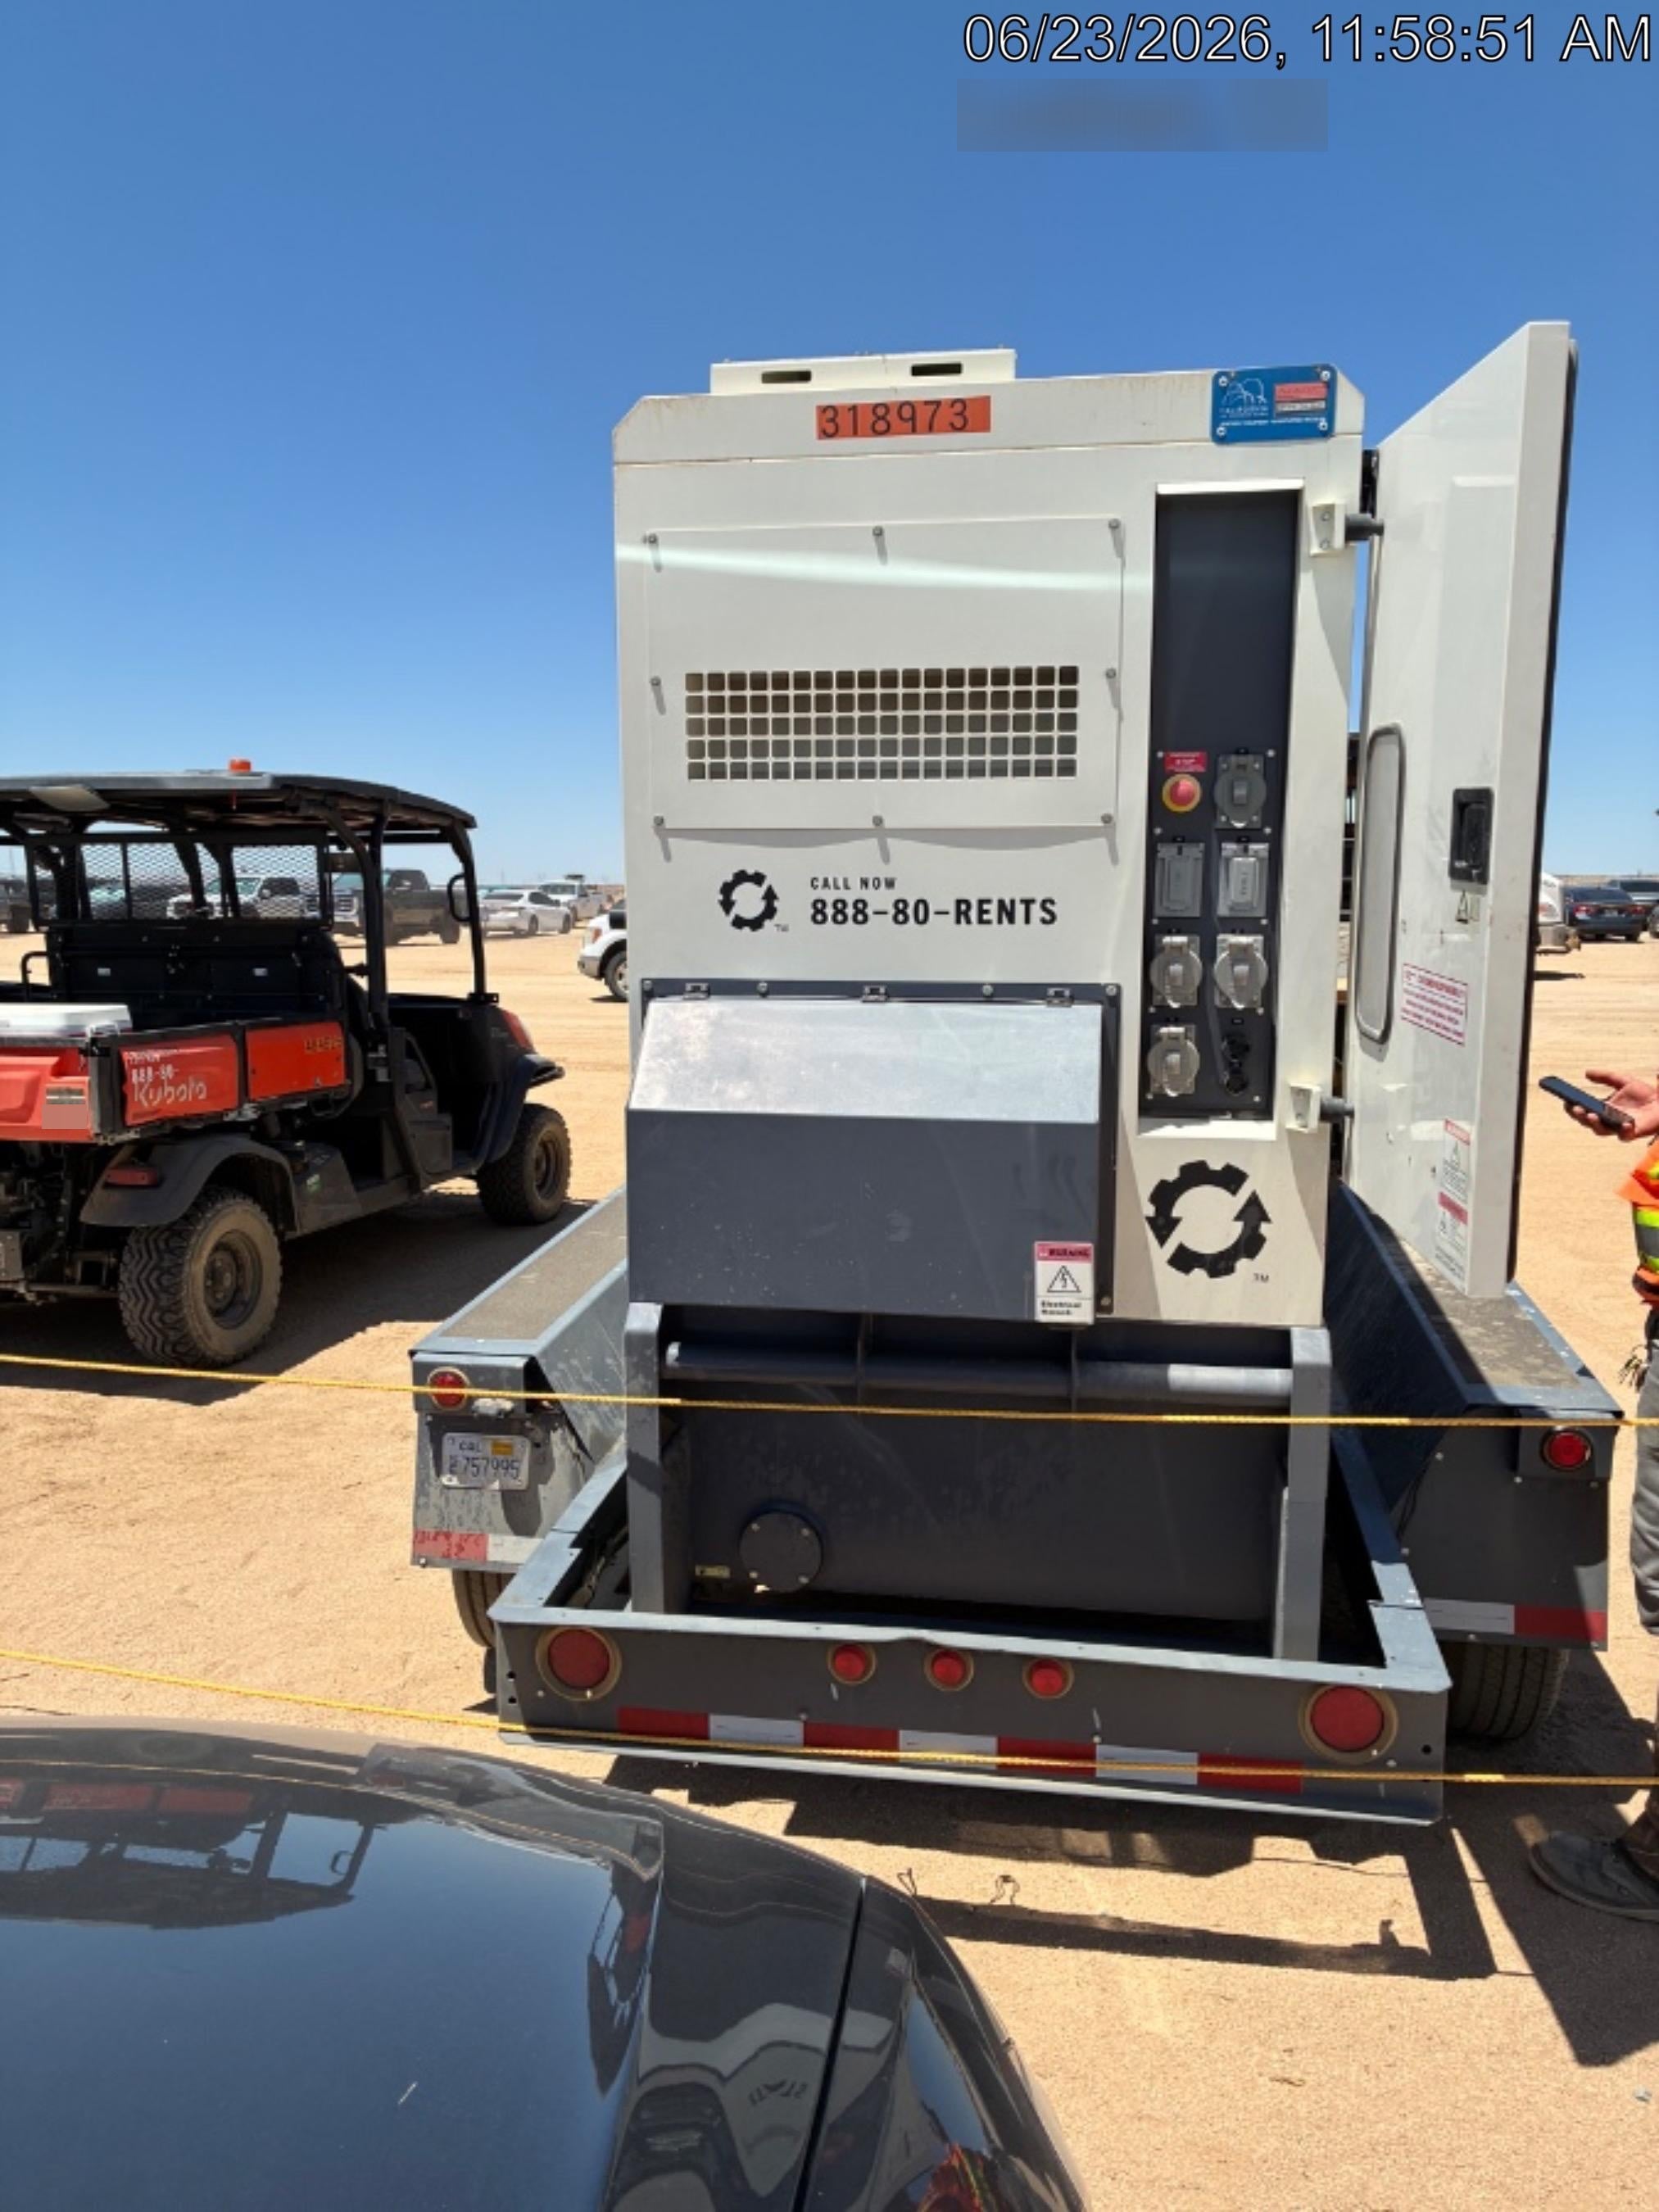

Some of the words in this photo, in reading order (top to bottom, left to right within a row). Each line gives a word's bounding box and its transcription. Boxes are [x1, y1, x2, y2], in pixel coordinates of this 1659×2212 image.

[820, 398, 969, 438] 318973
[810, 877, 851, 891] CALL
[859, 877, 896, 891] NOW
[810, 898, 1057, 926] 888-80-RENTS
[1253, 1272, 1269, 1283] TM
